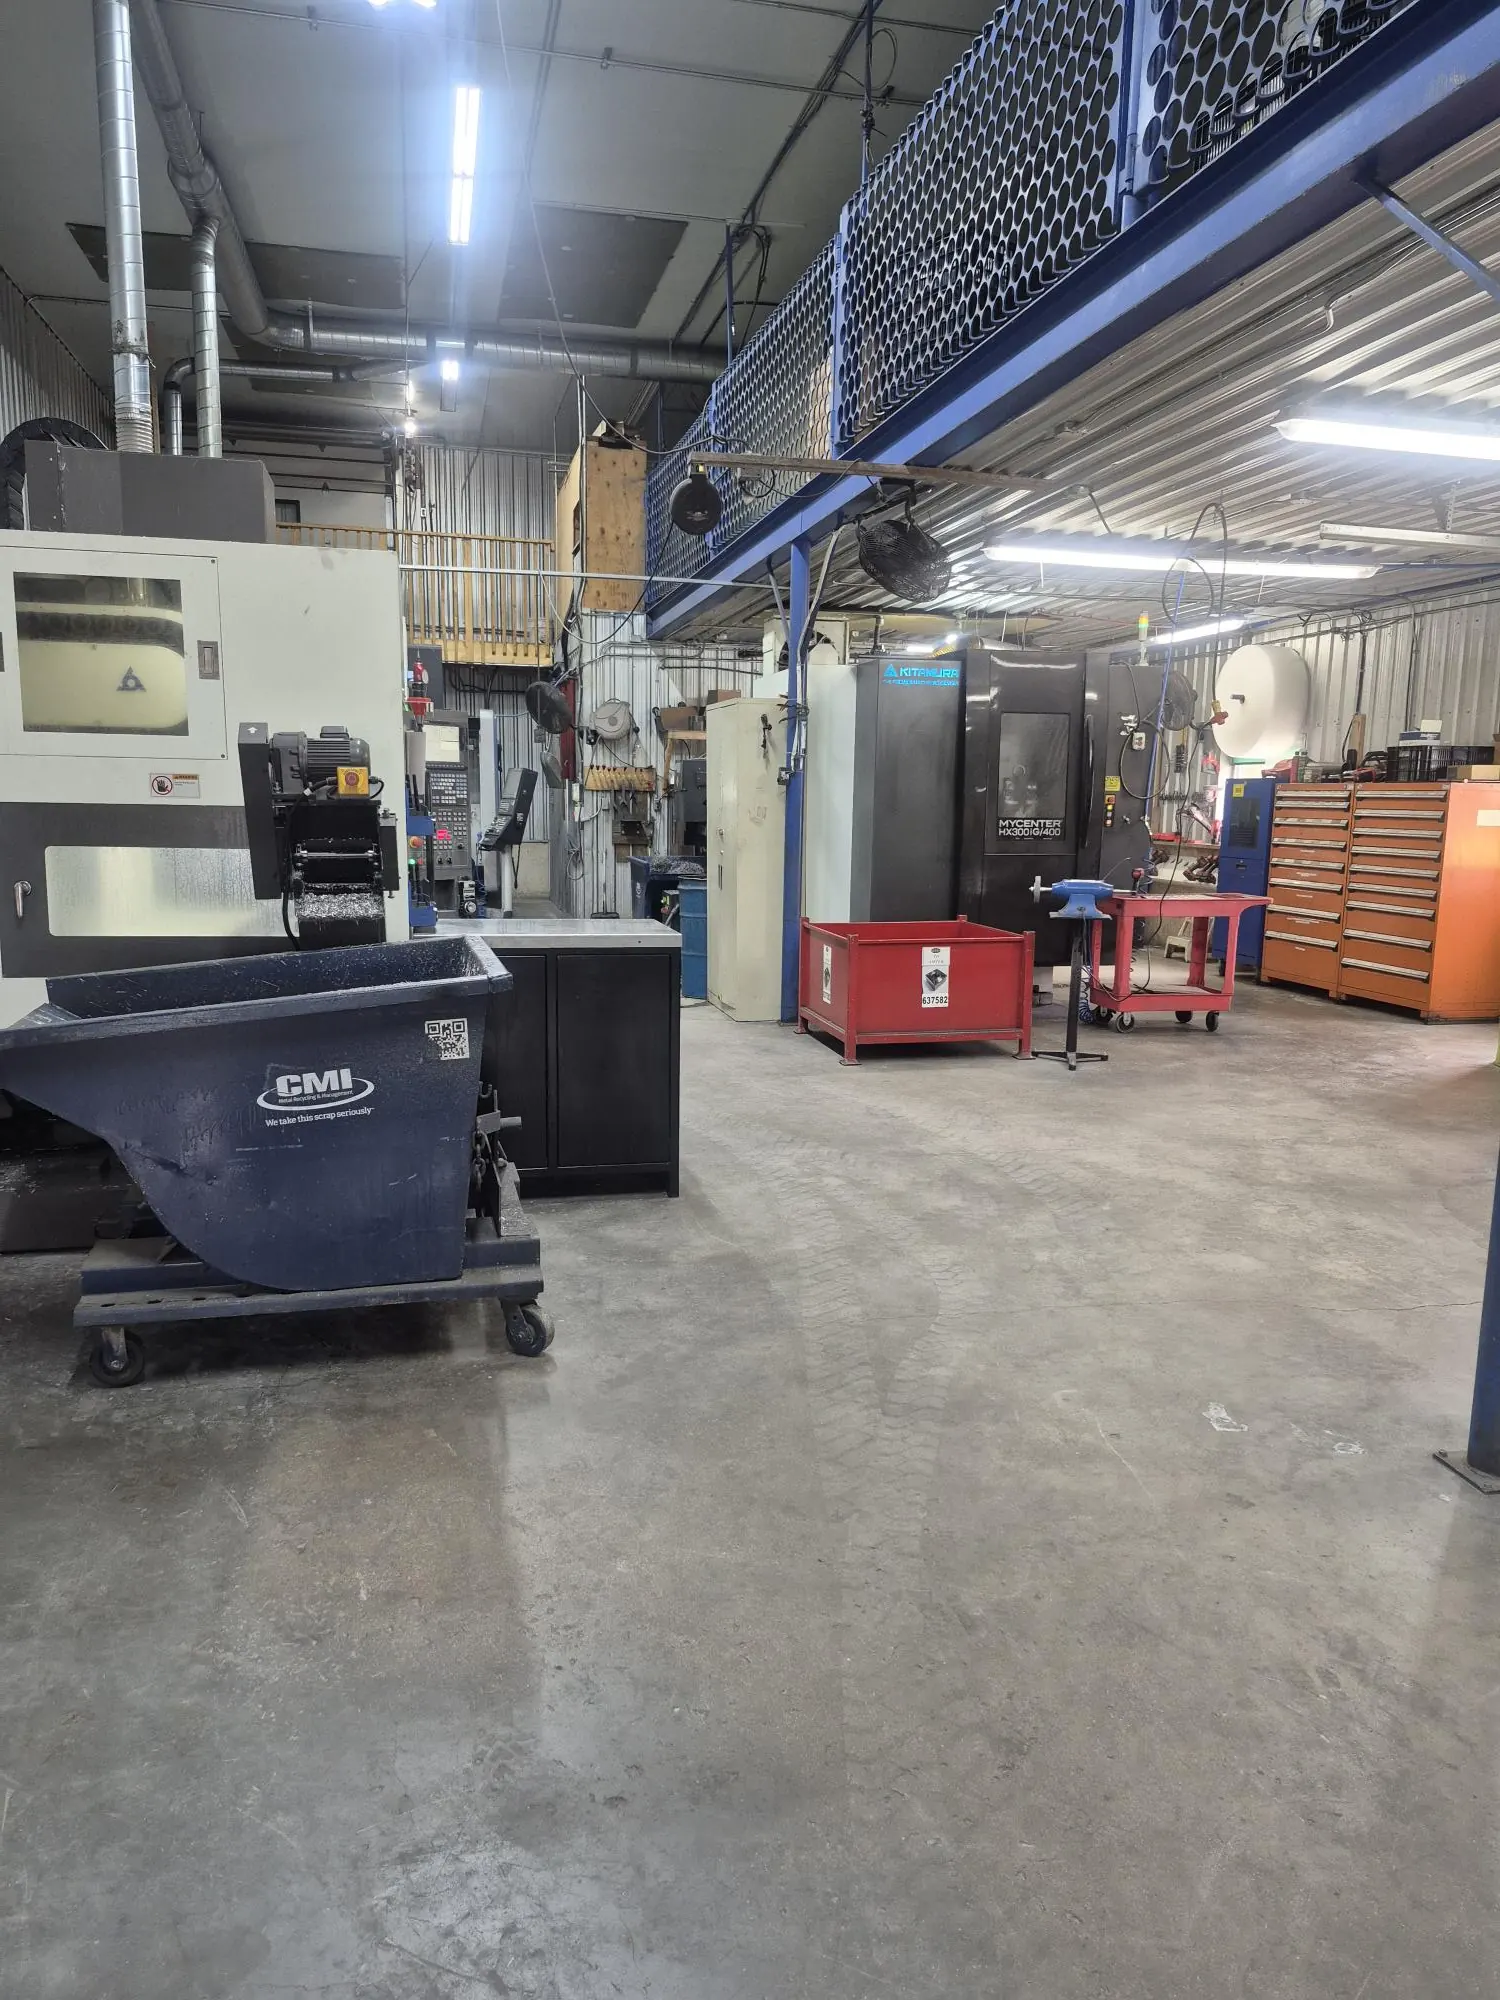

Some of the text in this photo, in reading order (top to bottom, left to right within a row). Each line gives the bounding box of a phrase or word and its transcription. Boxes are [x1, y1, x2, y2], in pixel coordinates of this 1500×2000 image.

[900, 667, 959, 678] KITAMURA
[999, 819, 1061, 828] MYCENTER
[922, 996, 948, 1005] 637582
[275, 1068, 353, 1097] CMI
[293, 1094, 317, 1102] Recycling
[265, 1118, 279, 1127] We
[279, 1116, 297, 1126] take
[297, 1114, 314, 1123] this
[314, 1112, 336, 1121] scrap
